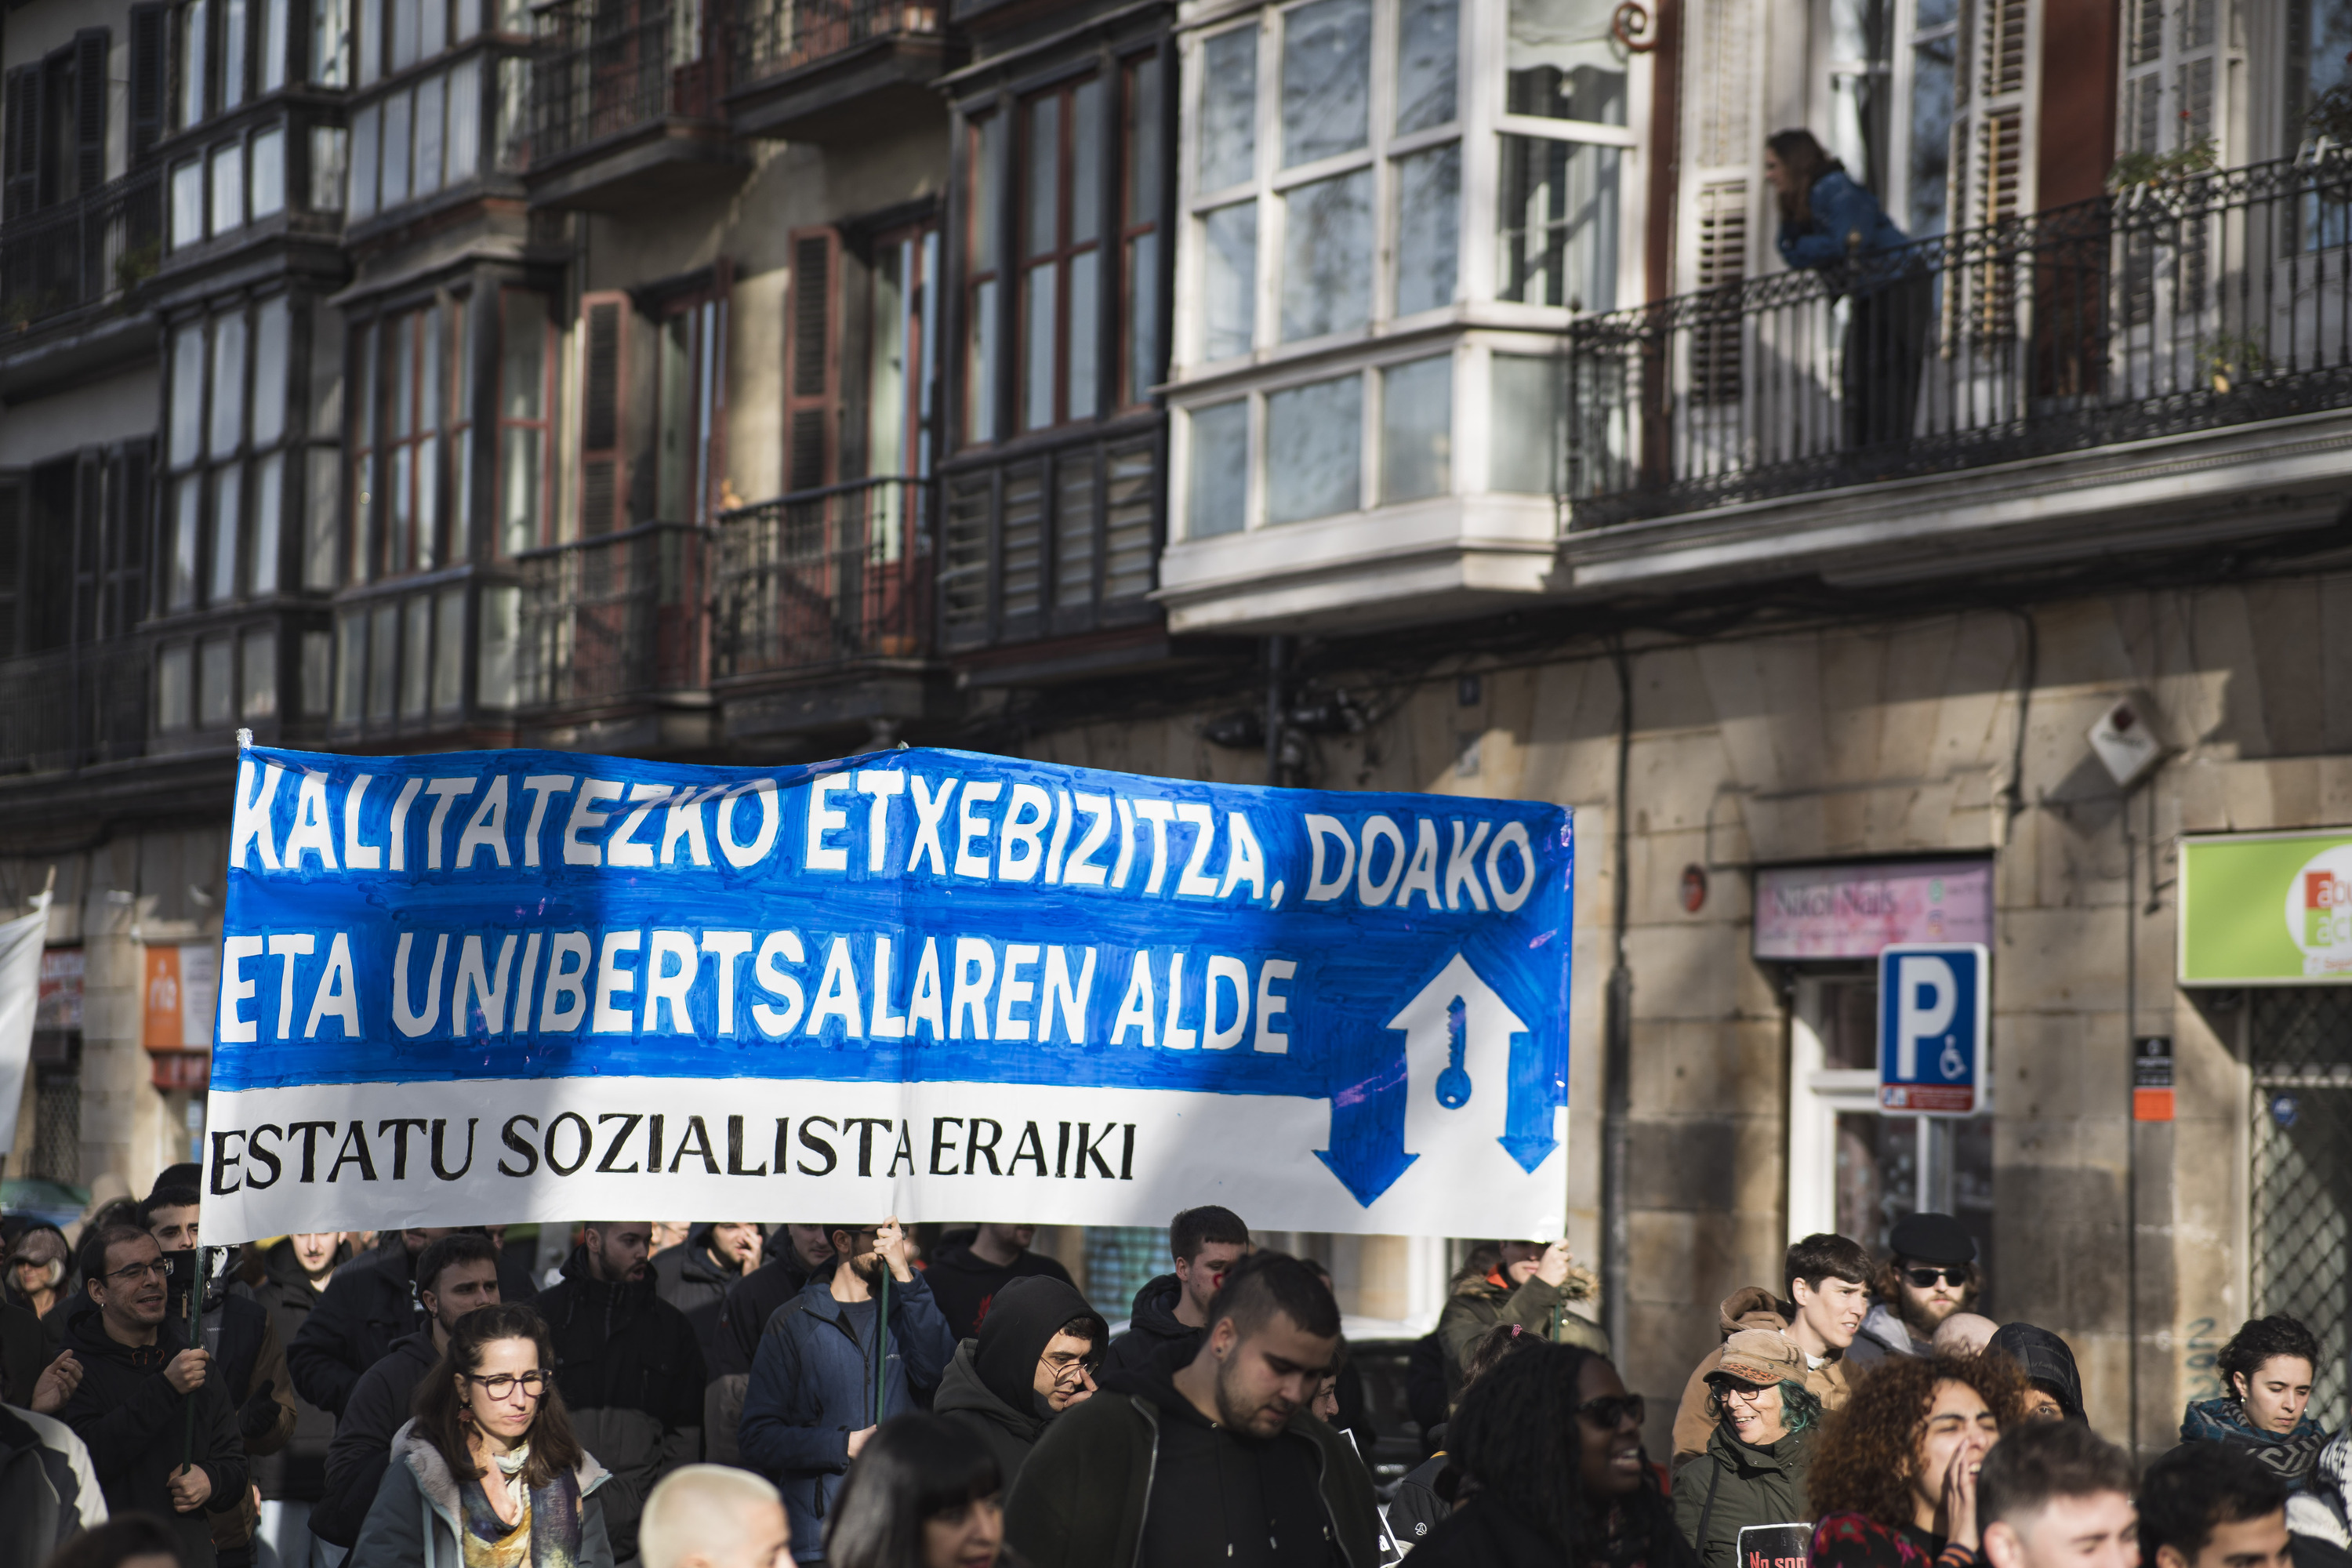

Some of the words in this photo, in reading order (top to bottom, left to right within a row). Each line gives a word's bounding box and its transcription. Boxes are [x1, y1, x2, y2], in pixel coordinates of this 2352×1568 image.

[230, 760, 779, 869] KALITATEZKO
[805, 768, 1287, 910] ETXEBIZITZA,
[1304, 813, 1535, 913] DOAKO
[1842, 880, 1896, 915] Nails
[220, 931, 361, 1043] ETA
[392, 929, 1097, 1044] UNIBERTSALAREN
[1109, 949, 1298, 1054] ALDE
[1896, 955, 1958, 1081] P
[210, 1117, 479, 1196] ESTATU
[497, 1112, 915, 1179] SOZIALISTA
[929, 1116, 1136, 1181] ERAIKI
[1749, 1551, 1769, 1568] No
